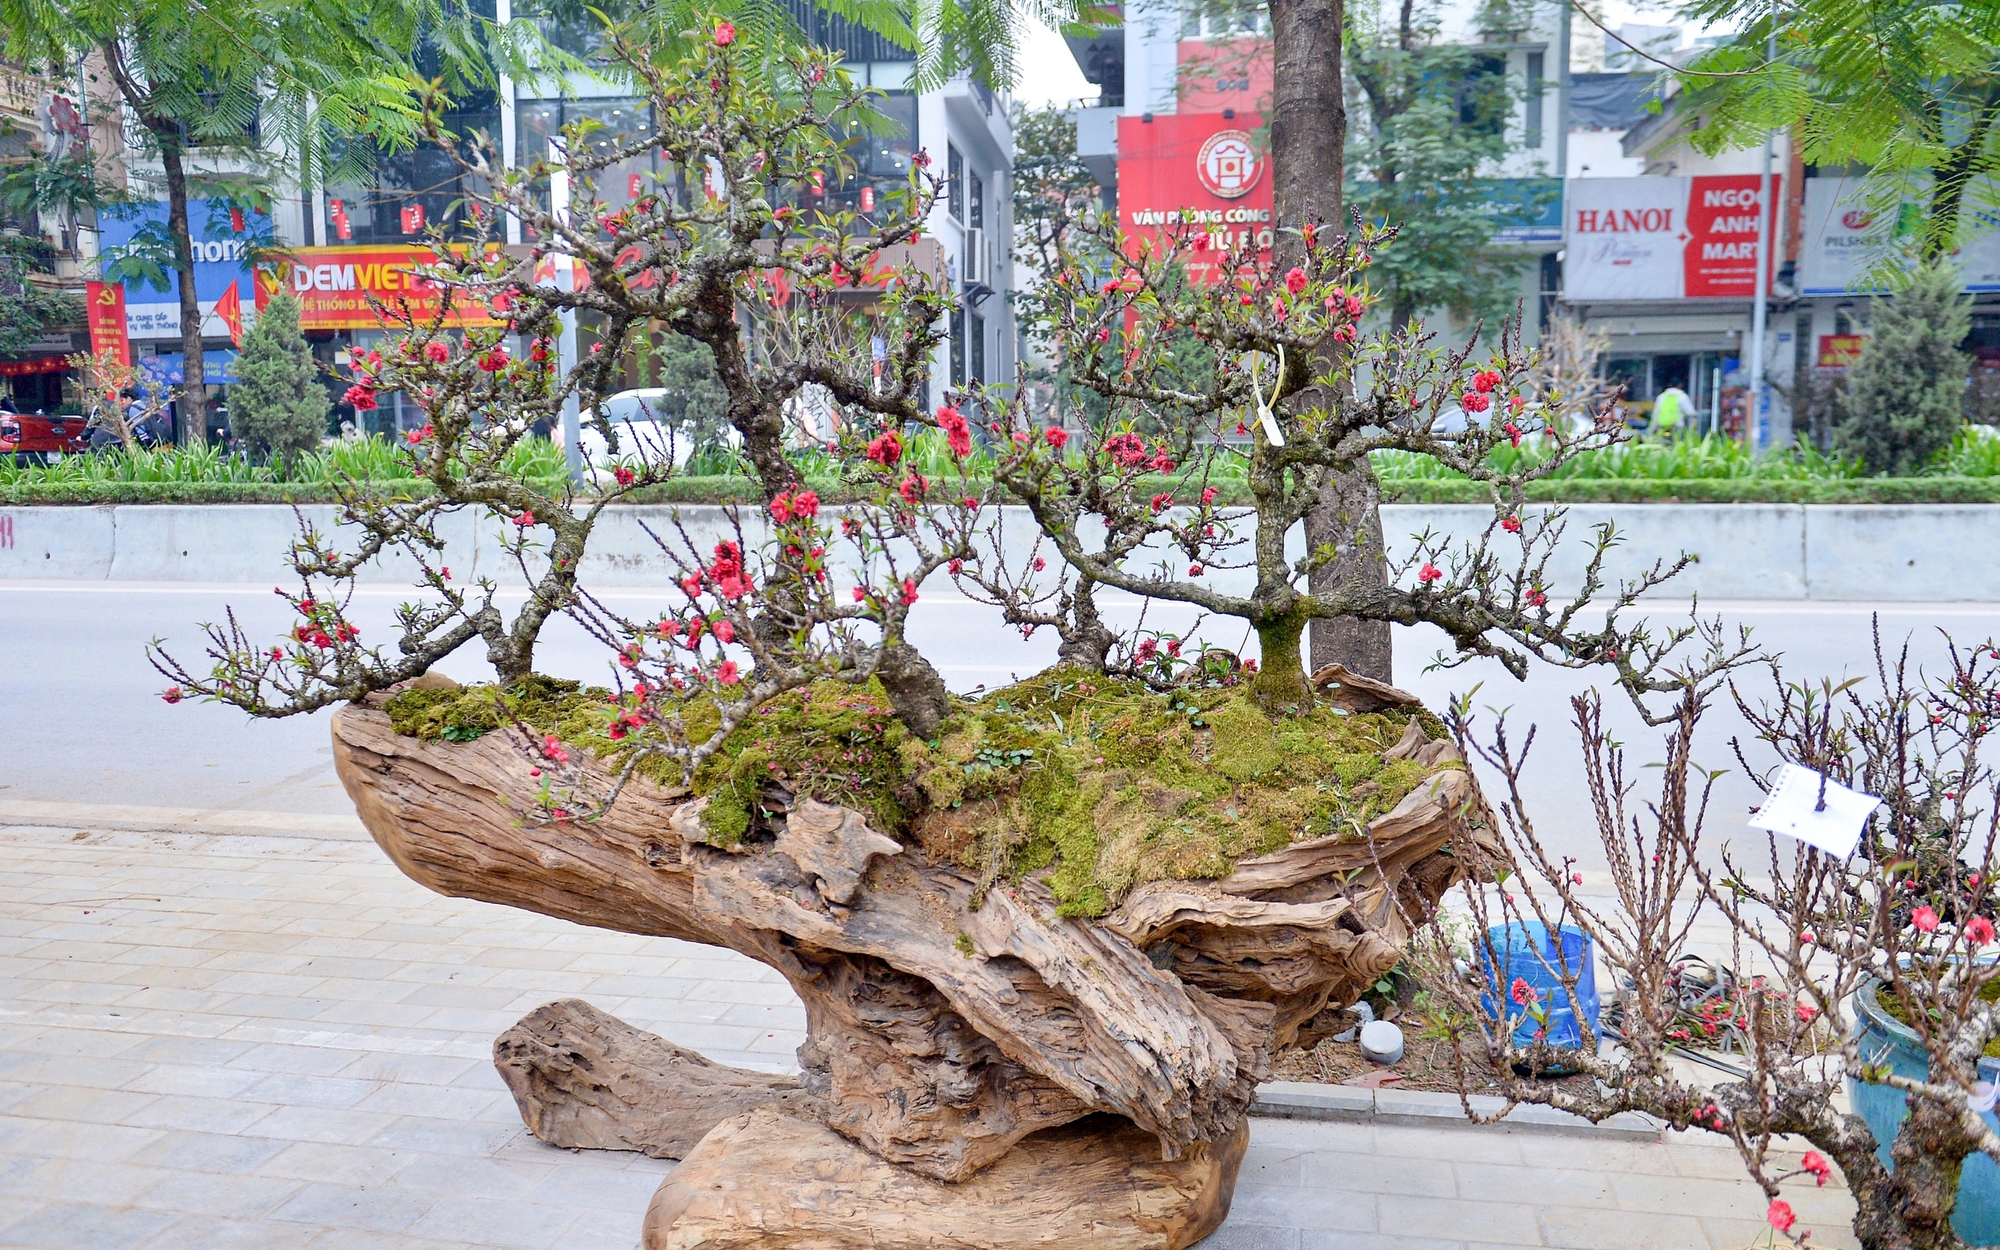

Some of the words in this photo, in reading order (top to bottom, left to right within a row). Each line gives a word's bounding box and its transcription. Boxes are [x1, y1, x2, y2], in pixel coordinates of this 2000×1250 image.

[1132, 207, 1165, 226] VĂN
[1225, 206, 1270, 224] CÔNG
[1576, 208, 1674, 233] HANOI
[1709, 216, 1760, 234] ANH
[316, 294, 356, 311] THỐNG
